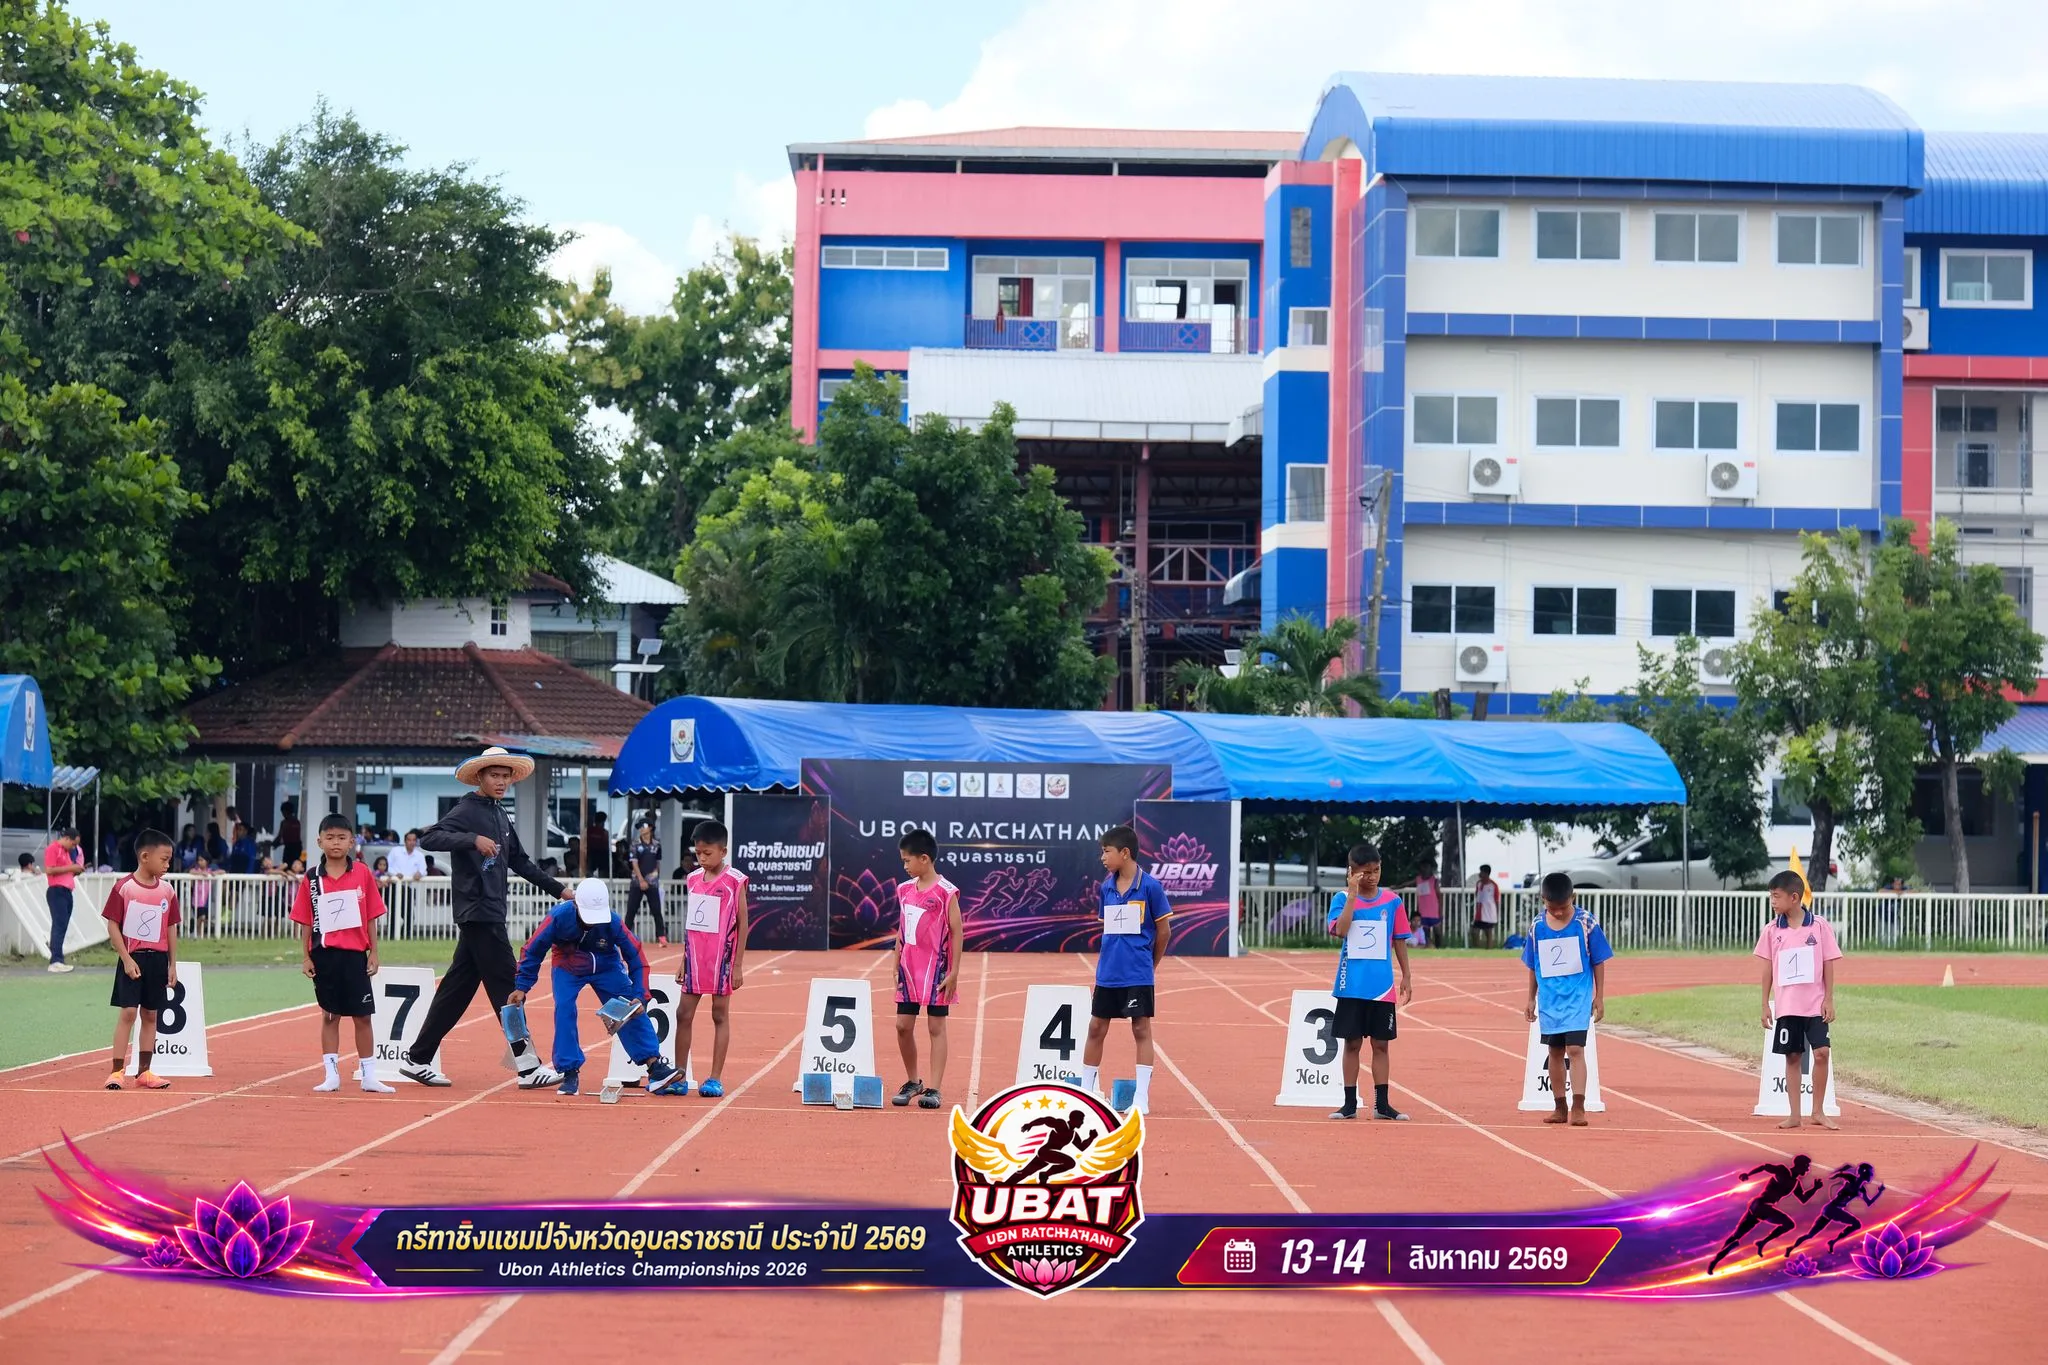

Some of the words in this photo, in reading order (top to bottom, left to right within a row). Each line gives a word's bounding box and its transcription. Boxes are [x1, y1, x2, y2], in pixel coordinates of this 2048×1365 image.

[858, 820, 936, 838] UBON
[949, 821, 1117, 841] RATCHATHAN
[939, 849, 1046, 867] .อุบลราชธานี
[1150, 863, 1219, 880] UBON
[1163, 880, 1215, 889] THLETICS
[327, 898, 345, 924] 7
[694, 899, 706, 924] 6
[1113, 908, 1129, 929] 4
[136, 909, 157, 937] 8
[1358, 925, 1377, 950] 3
[1550, 945, 1568, 967] 2
[1786, 952, 1805, 980] 1
[384, 983, 421, 1041] 7
[819, 995, 857, 1054] 5
[1039, 1004, 1076, 1061] 4
[153, 1039, 188, 1055] elco
[1302, 1007, 1339, 1066] 3
[376, 1044, 410, 1061] Nelc
[812, 1055, 856, 1074] Nelco
[1773, 1076, 1814, 1094] Nco
